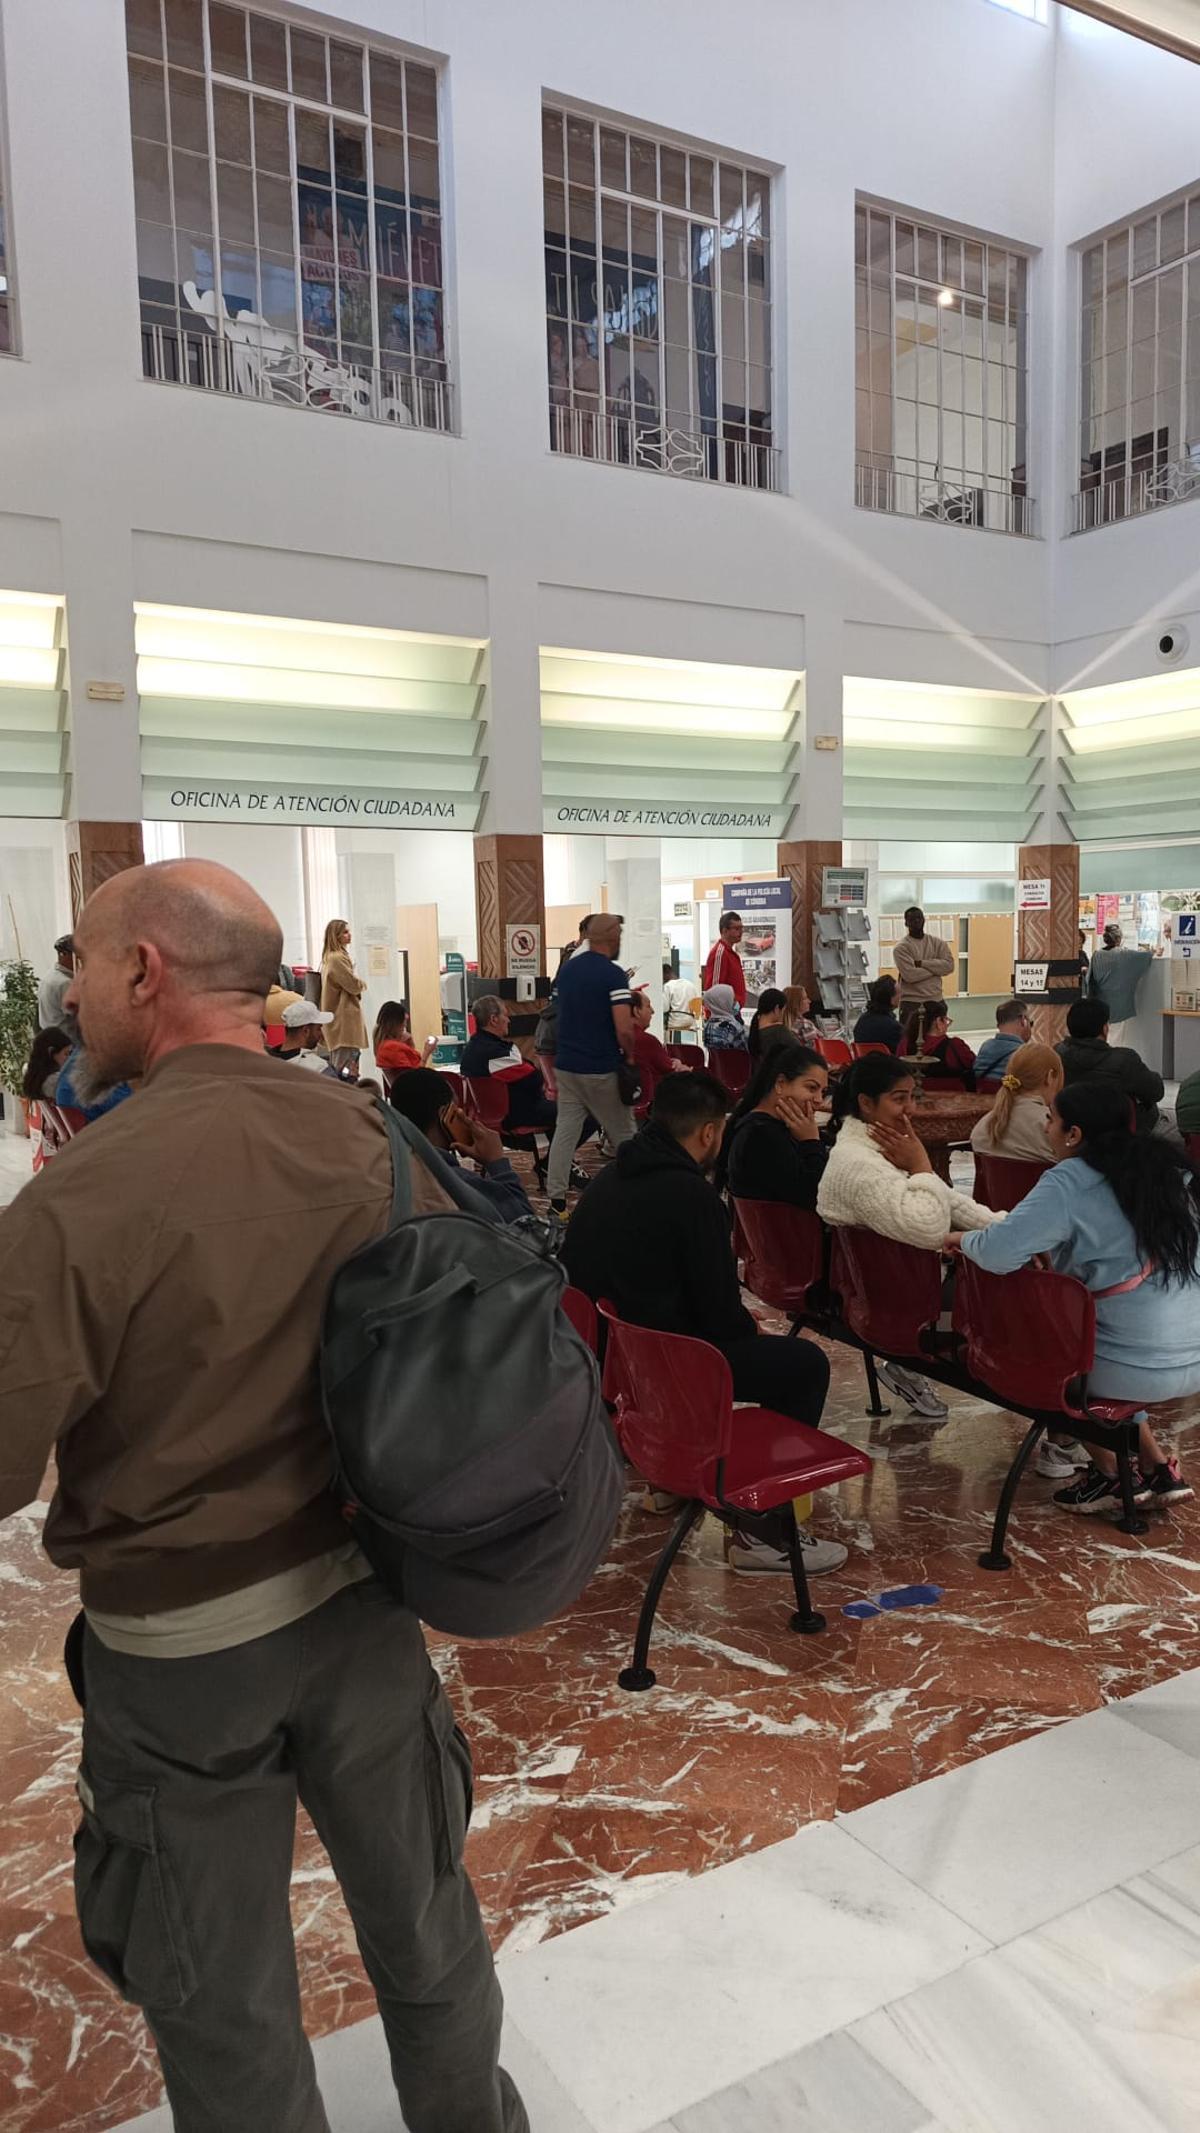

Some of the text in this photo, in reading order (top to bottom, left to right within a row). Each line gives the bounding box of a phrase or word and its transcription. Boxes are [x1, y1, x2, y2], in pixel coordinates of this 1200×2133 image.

[170, 790, 456, 817] OFICINA DE ATENCIÓN CIUDADANA
[556, 807, 772, 827] OFICINA DE ATENCIÓN CIUDADANA
